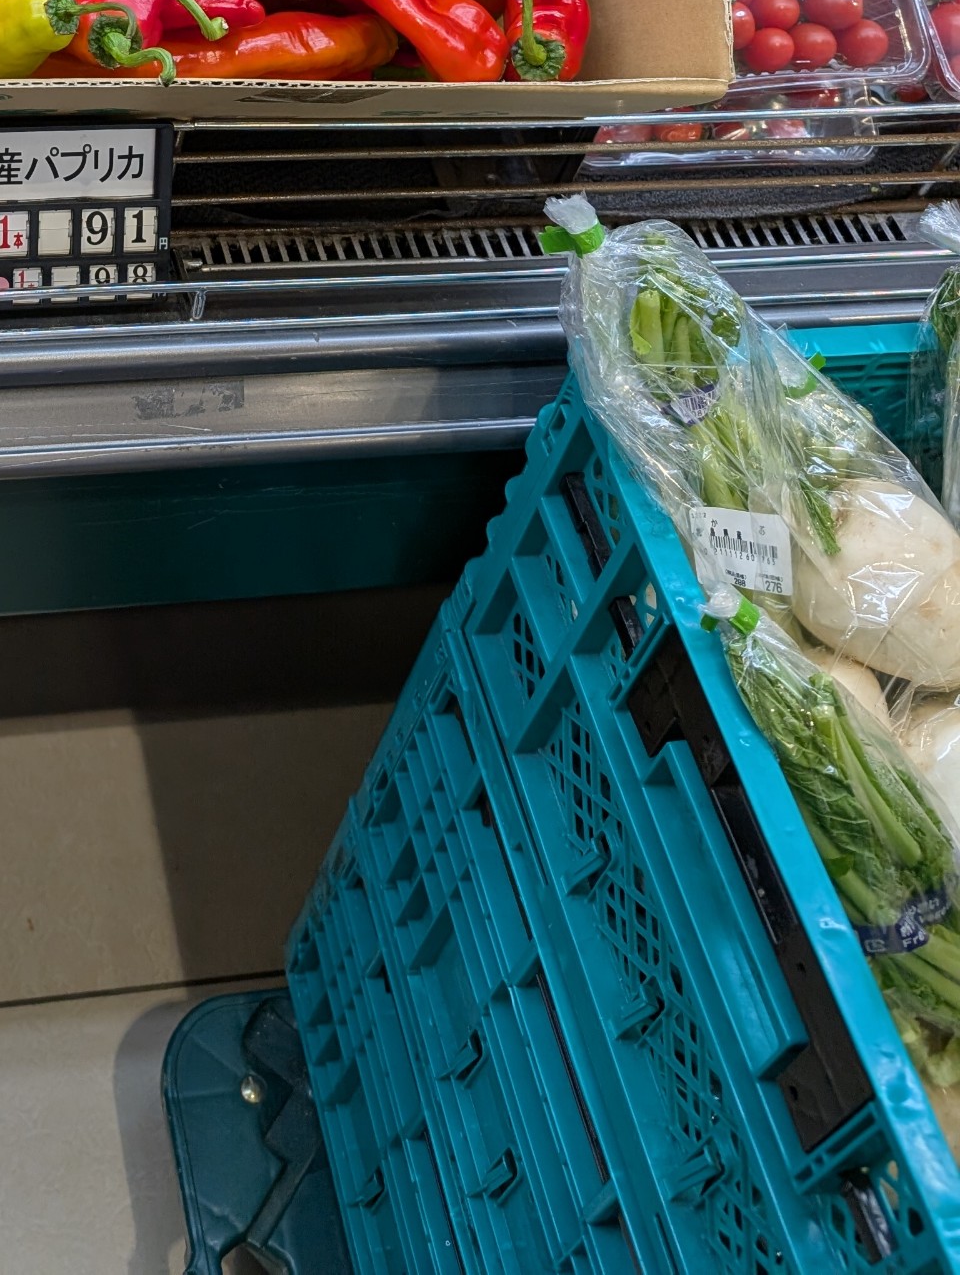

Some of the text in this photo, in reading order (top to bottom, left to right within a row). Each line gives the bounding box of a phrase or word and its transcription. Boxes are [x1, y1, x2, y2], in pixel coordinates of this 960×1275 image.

[0, 215, 23, 249] 1本
[86, 210, 147, 245] 91
[159, 237, 168, 250] 円
[765, 580, 783, 593] 276
